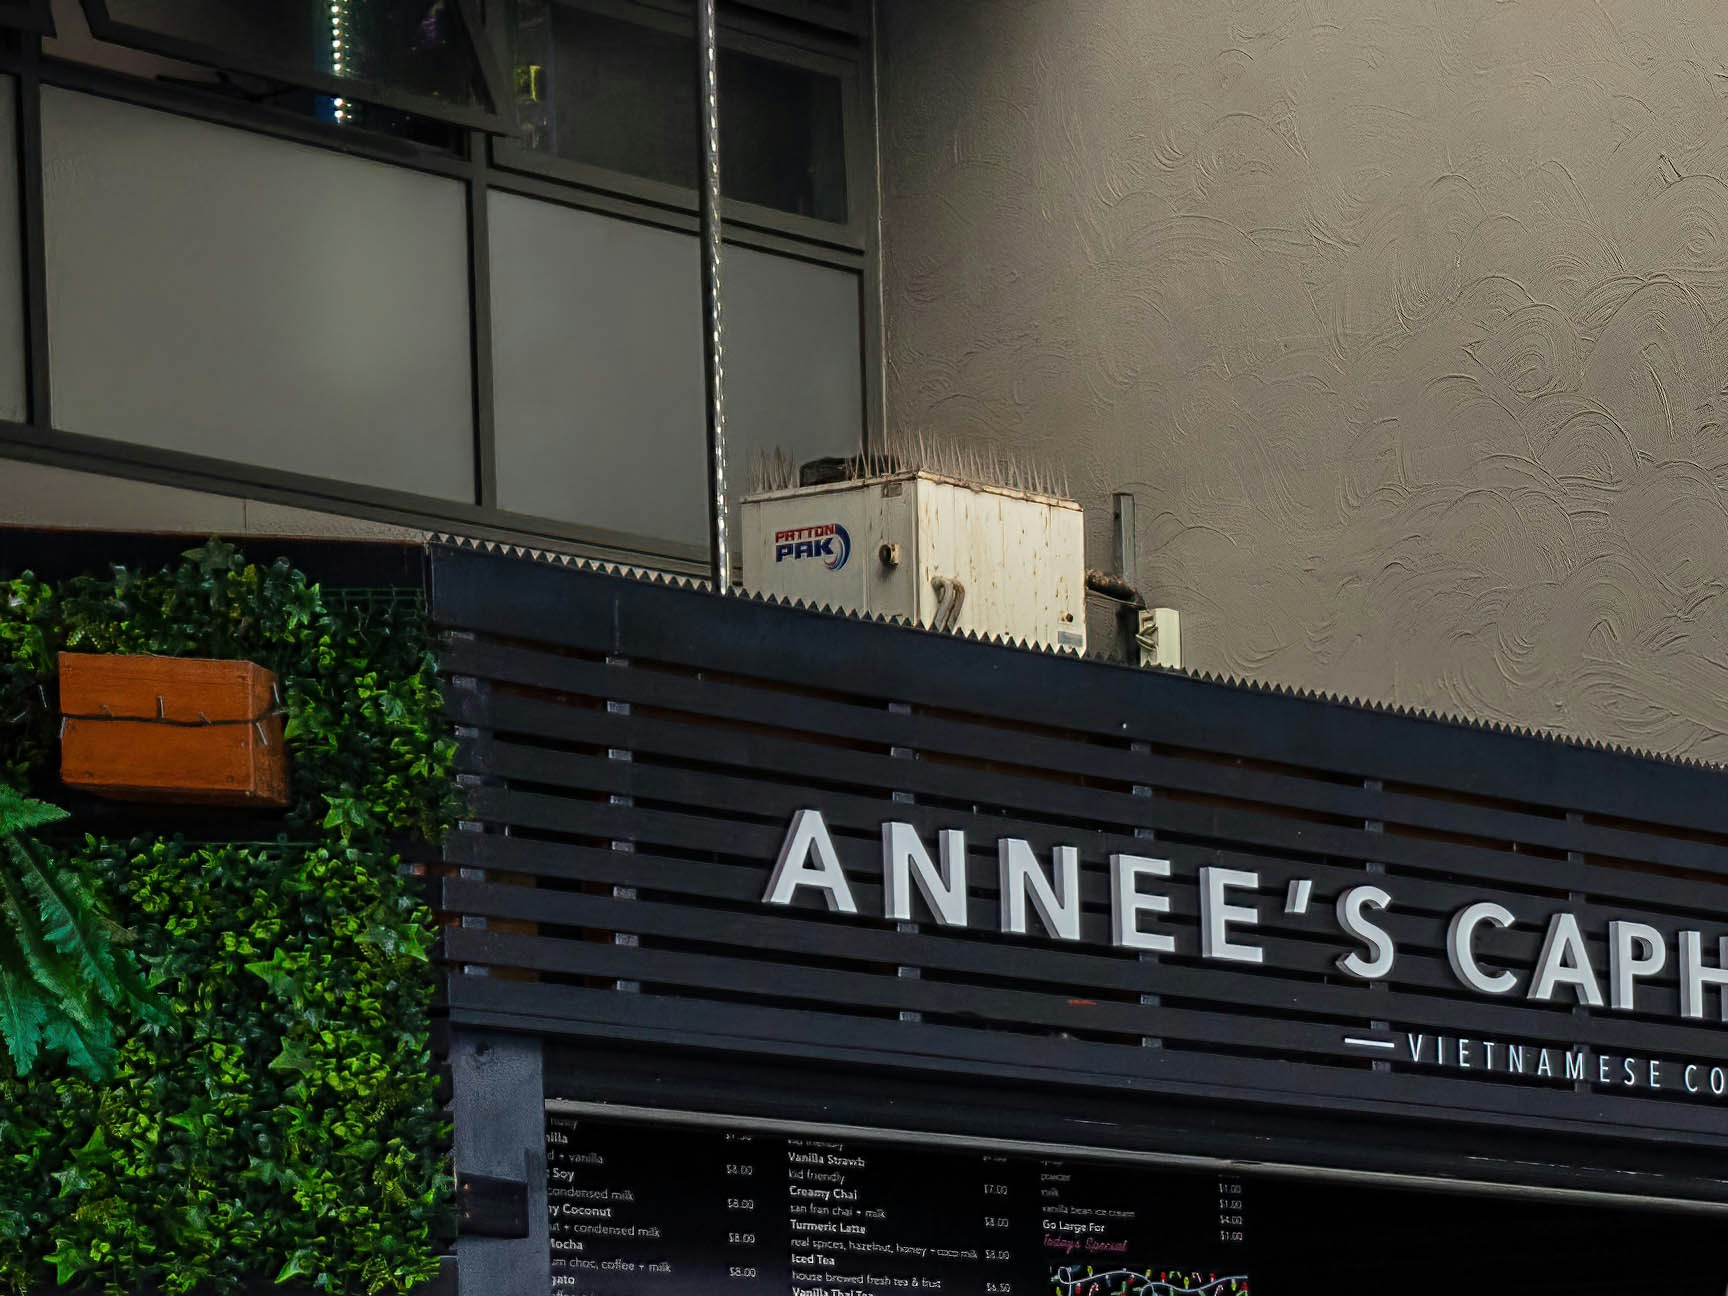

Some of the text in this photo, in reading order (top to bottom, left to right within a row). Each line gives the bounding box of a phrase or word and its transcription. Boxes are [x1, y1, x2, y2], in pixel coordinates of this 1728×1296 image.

[776, 538, 834, 562] PAK
[762, 809, 1397, 980] ANNEE'S
[1407, 1033, 1663, 1090] VIETNAMESE
[788, 1152, 824, 1165] Vanilla
[553, 1168, 574, 1182] Soy
[789, 1186, 859, 1200] Creamy Chai
[563, 1204, 612, 1217] Coconut
[790, 1219, 837, 1233] Turmeric
[1043, 1220, 1105, 1233] Go Large For
[791, 1254, 835, 1266] Iced Tea
